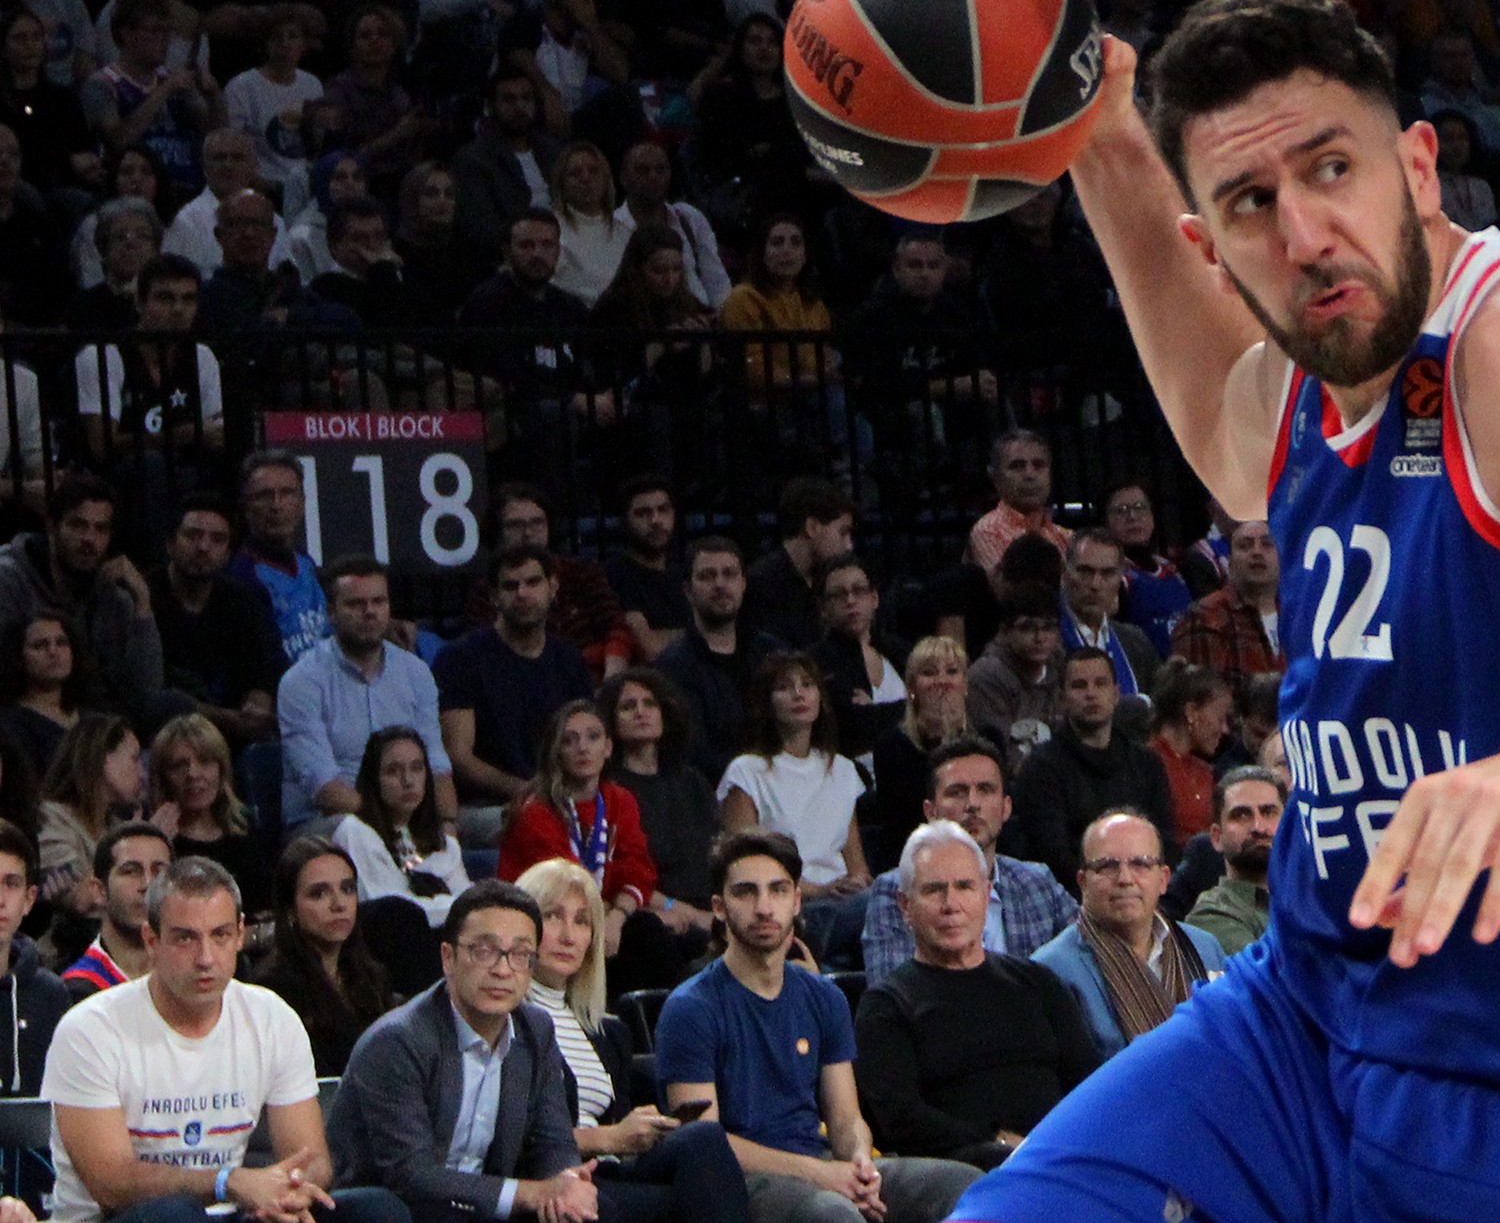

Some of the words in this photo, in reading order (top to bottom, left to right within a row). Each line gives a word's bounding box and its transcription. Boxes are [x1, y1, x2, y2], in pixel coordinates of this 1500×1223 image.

[144, 404, 163, 433] 6
[304, 415, 361, 440] BLOK
[376, 415, 445, 440] BLOCK
[296, 452, 480, 567] 118
[1303, 524, 1394, 661] 22
